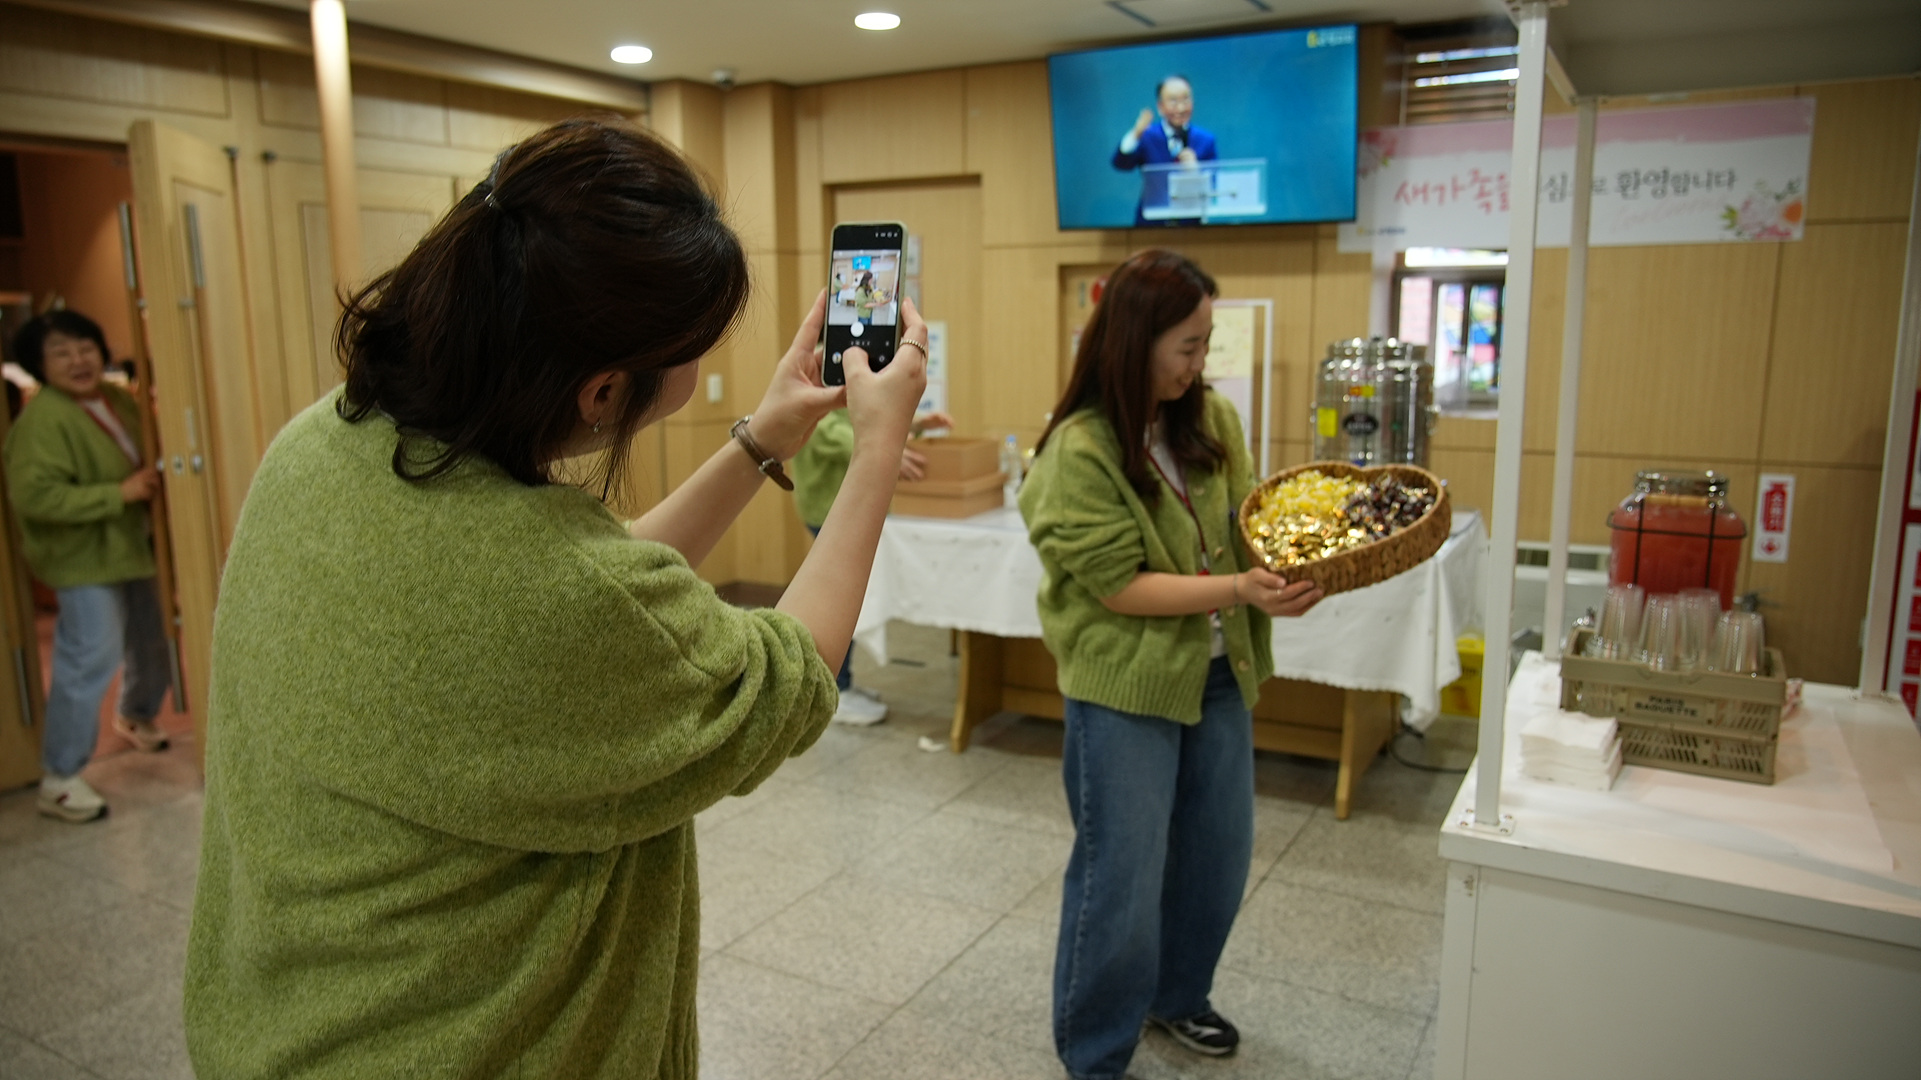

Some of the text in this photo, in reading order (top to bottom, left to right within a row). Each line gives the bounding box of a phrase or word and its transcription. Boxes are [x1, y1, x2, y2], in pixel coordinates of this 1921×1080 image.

[1616, 166, 1737, 200] 환영합니다
[1649, 695, 1685, 706] PARIS
[1634, 701, 1698, 717] BAGUETTE
